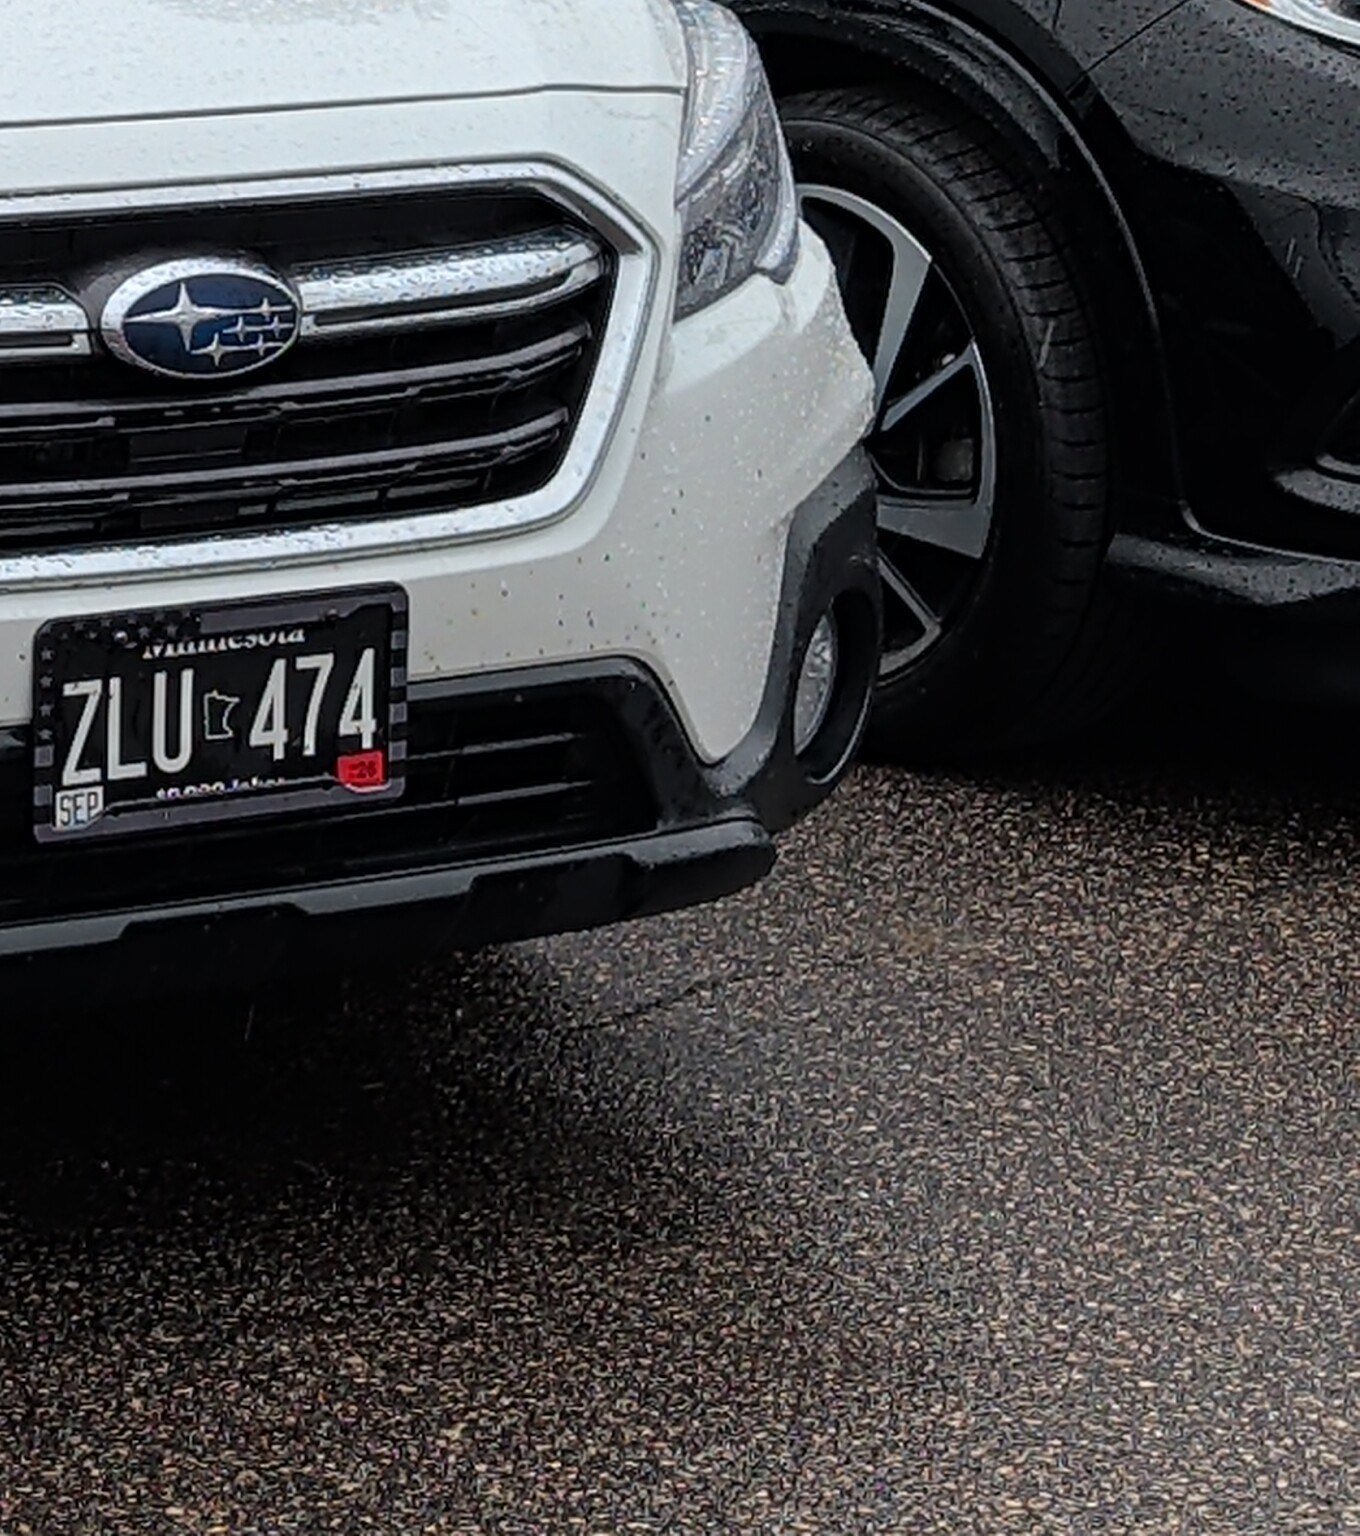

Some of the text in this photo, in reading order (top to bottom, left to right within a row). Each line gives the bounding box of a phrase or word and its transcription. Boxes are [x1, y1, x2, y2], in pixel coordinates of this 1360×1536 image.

[62, 648, 377, 786] ZLU 474
[60, 792, 98, 826] SEP
